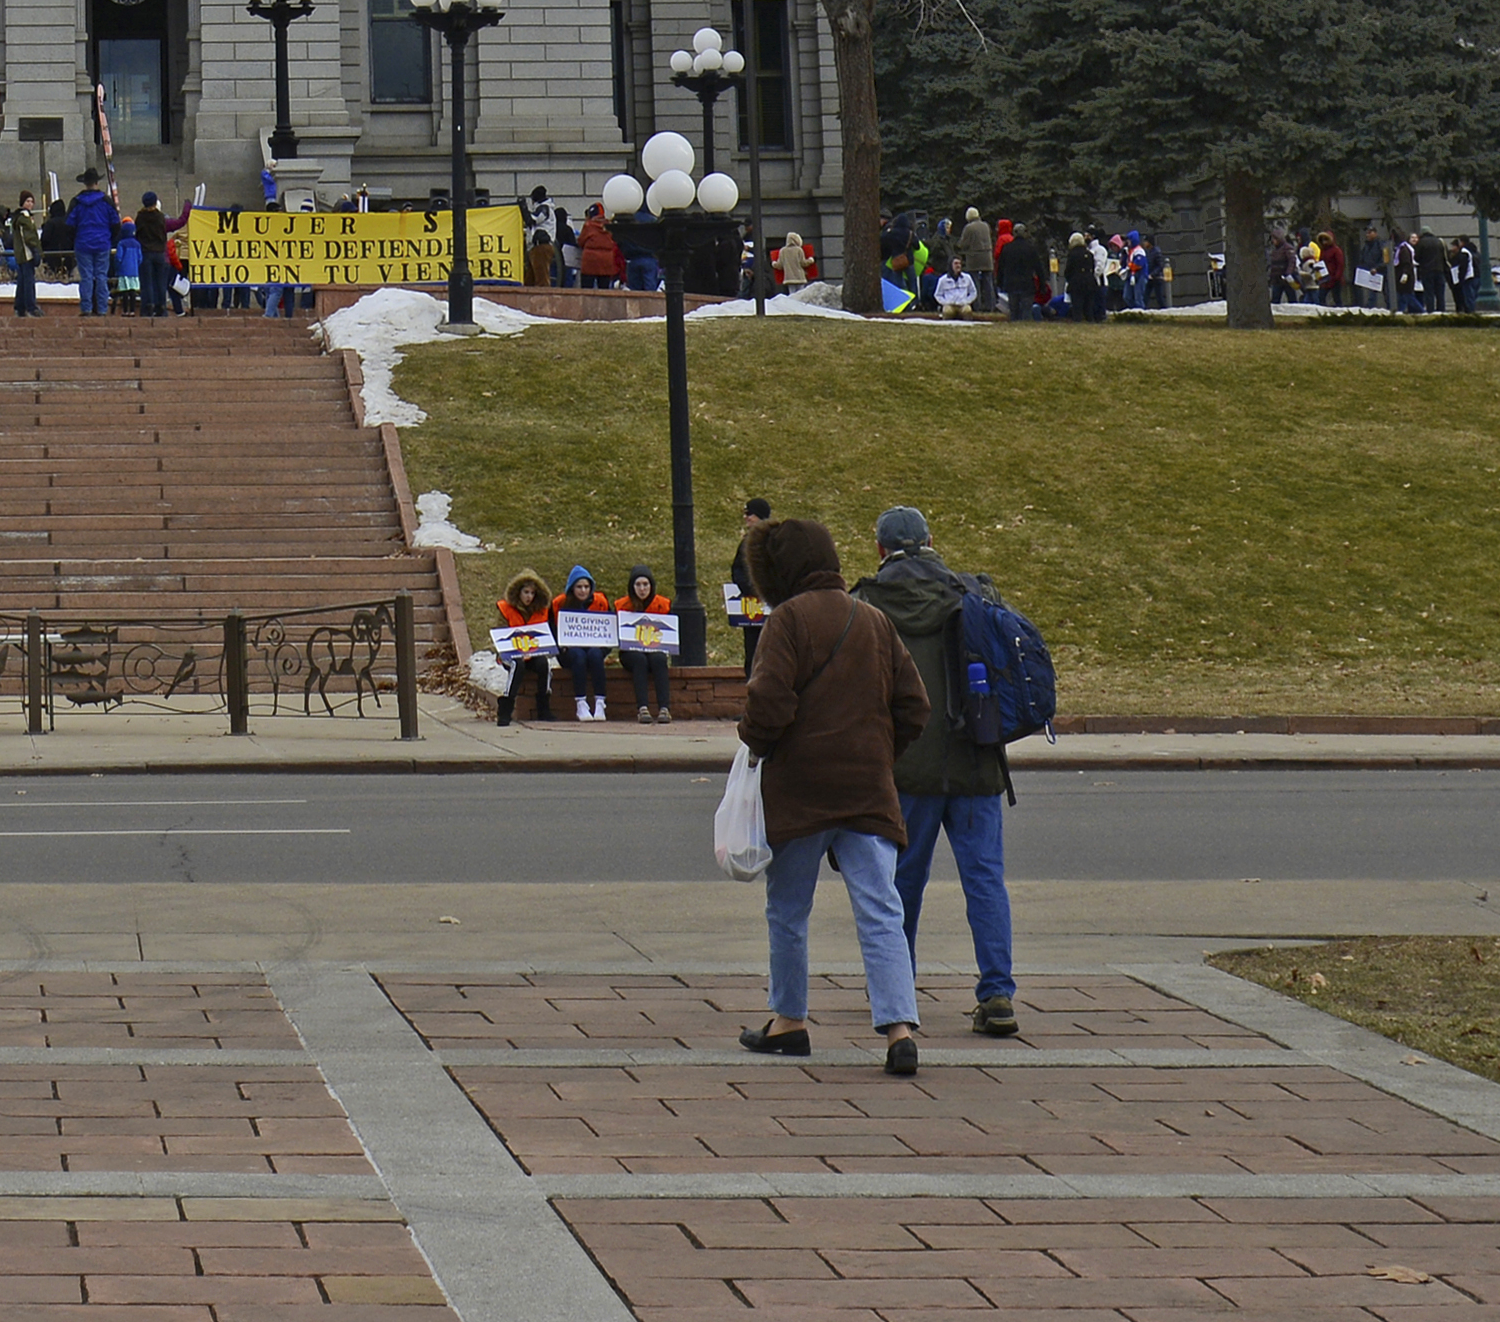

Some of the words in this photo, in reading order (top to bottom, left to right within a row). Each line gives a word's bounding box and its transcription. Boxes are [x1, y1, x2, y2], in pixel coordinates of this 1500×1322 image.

[217, 211, 356, 234] MUJER
[191, 240, 314, 260] VALIENTE
[478, 234, 511, 254] EL
[190, 264, 250, 283] HIJO
[265, 264, 300, 284] EN
[324, 265, 359, 284] TU
[377, 258, 513, 283] VIENRE
[564, 616, 578, 624] LIFE
[581, 617, 610, 626] GIVING
[568, 624, 608, 632] WOMEN'S
[563, 631, 612, 639] HEALTHCARE
